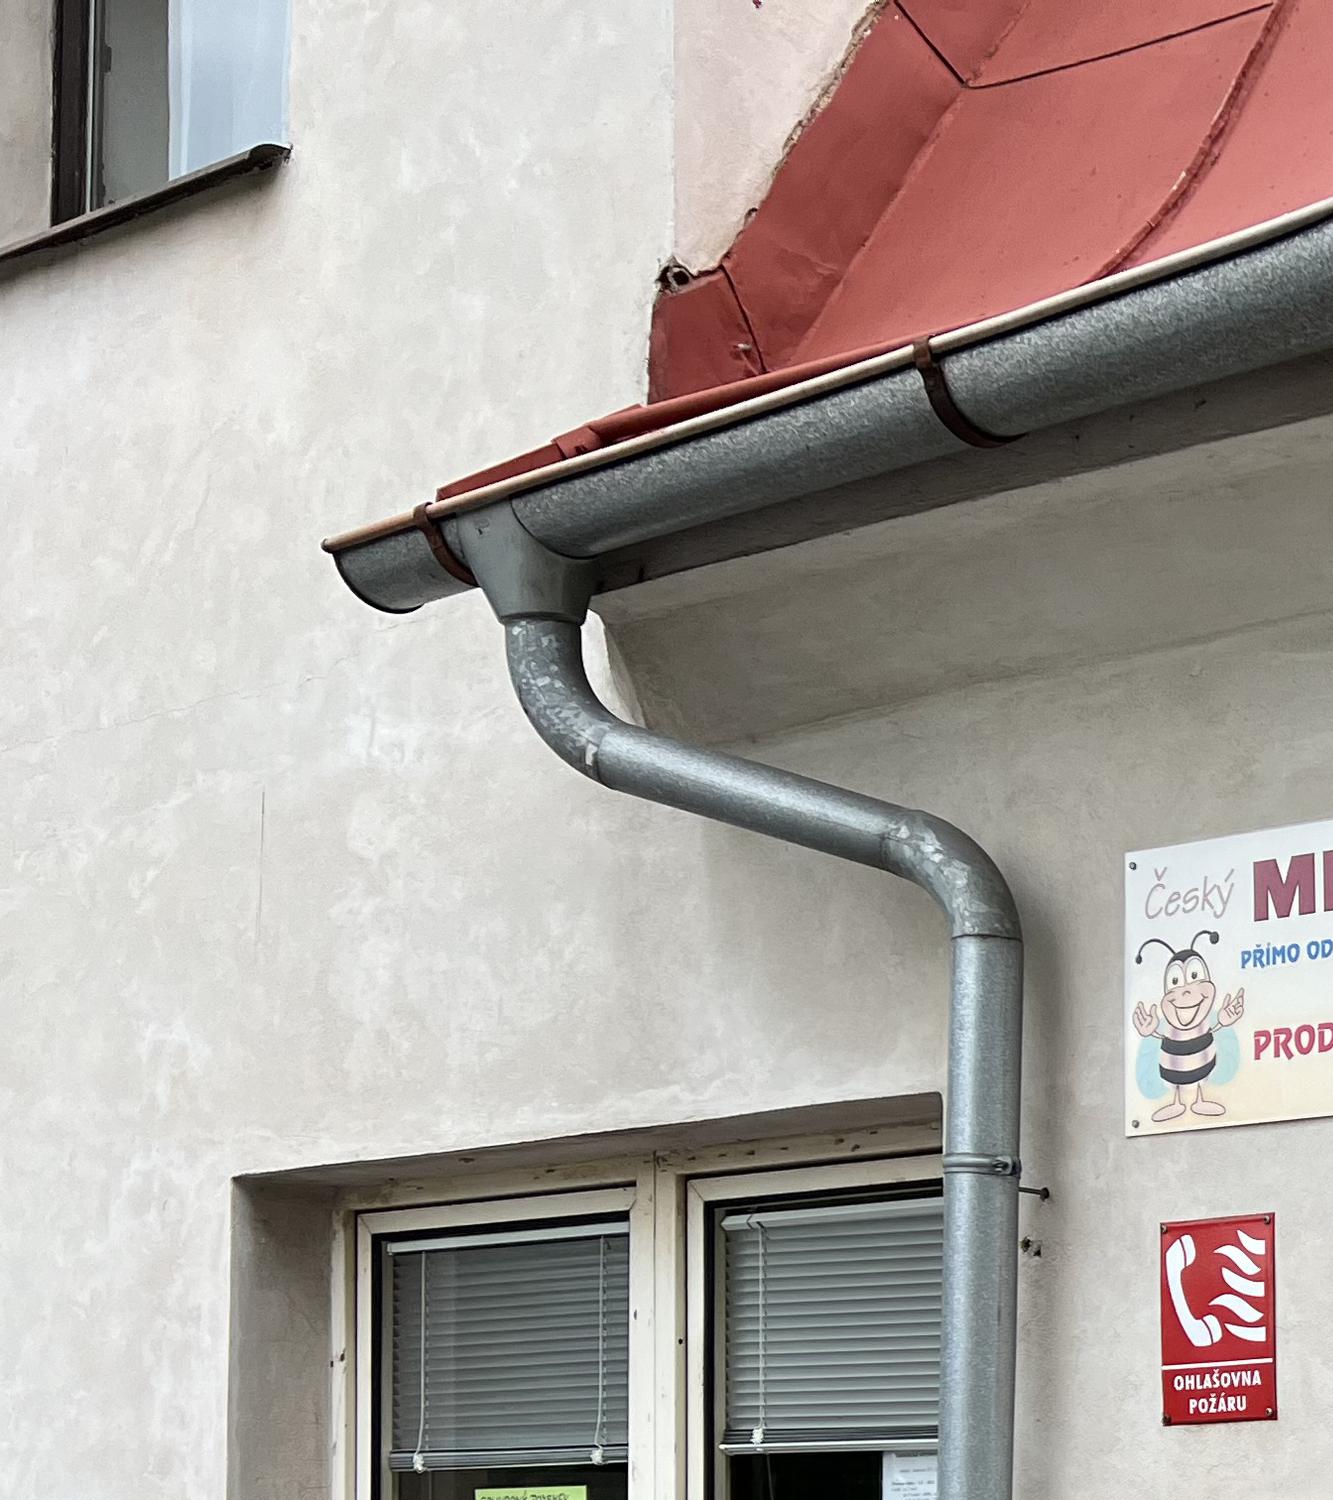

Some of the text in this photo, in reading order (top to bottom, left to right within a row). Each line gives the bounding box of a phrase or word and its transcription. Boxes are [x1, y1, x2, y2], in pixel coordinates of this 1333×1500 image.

[1144, 866, 1236, 920] Český
[1240, 941, 1301, 969] PŘÍMO
[1306, 938, 1333, 960] OD
[1173, 1368, 1262, 1391] OHLAŠOVNA
[1189, 1392, 1247, 1414] POŽÁRU
